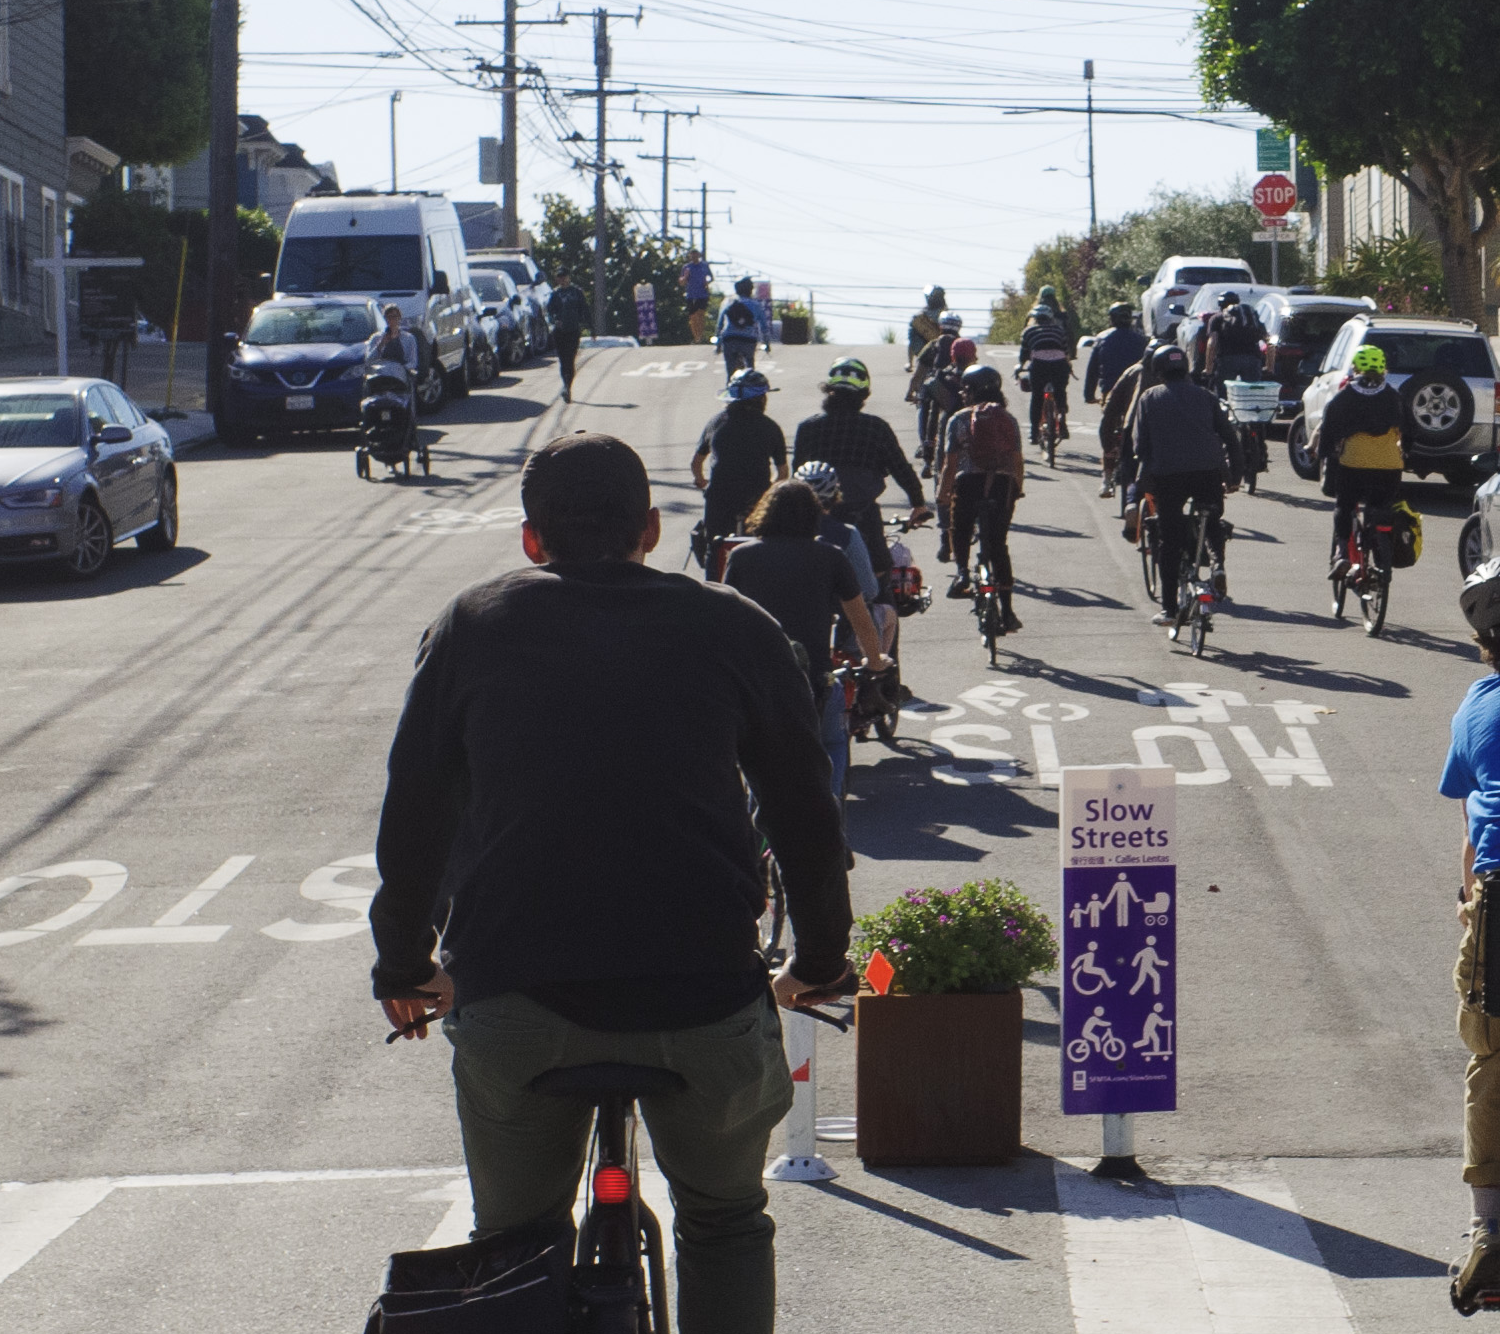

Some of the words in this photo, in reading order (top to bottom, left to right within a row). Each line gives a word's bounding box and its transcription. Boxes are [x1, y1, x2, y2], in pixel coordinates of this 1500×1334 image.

[1254, 186, 1296, 204] STOP
[930, 723, 1335, 787] SLOW
[1085, 798, 1154, 822] Slow
[1071, 826, 1169, 849] Streets
[1115, 854, 1140, 864] Calles
[1142, 854, 1170, 863] Lentas
